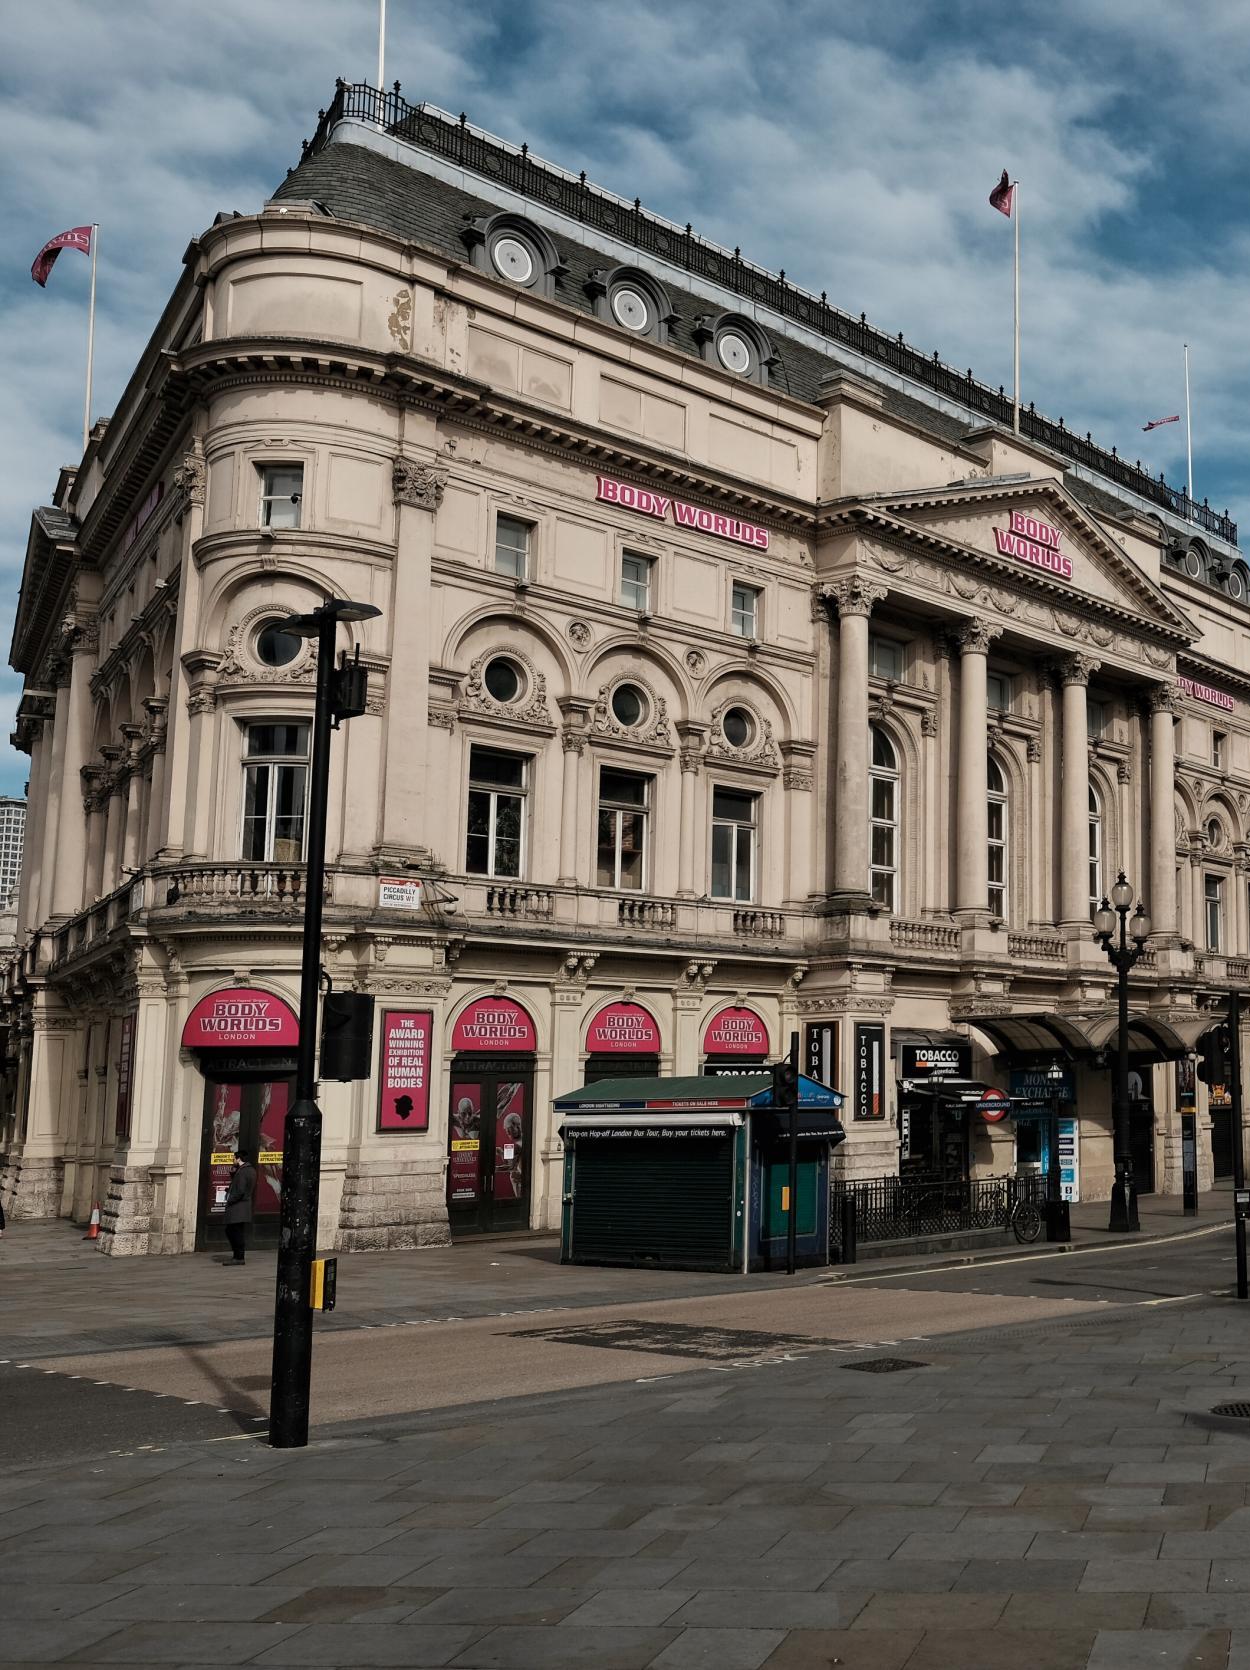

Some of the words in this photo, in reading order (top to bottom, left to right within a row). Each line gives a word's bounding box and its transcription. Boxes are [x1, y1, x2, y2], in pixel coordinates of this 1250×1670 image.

[596, 476, 672, 520] BODY
[671, 501, 769, 552] WORLDS
[1009, 509, 1063, 549] BODY
[993, 527, 1073, 580] WORLDS
[1177, 676, 1194, 695] DY
[1192, 685, 1235, 713] WORLDS
[384, 886, 416, 895] PICCADILLY
[213, 1002, 270, 1017] BODY
[200, 1017, 281, 1032] WORLDS
[400, 1020, 415, 1028] THE
[475, 1012, 518, 1025] BODY
[606, 1015, 645, 1028] BODY
[721, 1019, 755, 1031] BODY
[389, 1029, 424, 1039] AWARD
[462, 1024, 527, 1038] WORLDS
[595, 1027, 653, 1040] WORLDS
[712, 1030, 762, 1043] WORLDS
[389, 1039, 424, 1048] WINNING
[811, 1028, 820, 1079] TOBA
[915, 1050, 959, 1062] TOBACCO
[388, 1057, 399, 1066] OF
[401, 1057, 423, 1067] REAL
[387, 1067, 423, 1077] HUMAN
[387, 1078, 423, 1088] BODIES
[568, 1129, 588, 1138] Hop-on
[589, 1129, 610, 1138] Hop-off
[611, 1129, 632, 1137] London
[633, 1129, 644, 1137] Bus
[646, 1129, 660, 1137] Tour,
[661, 1129, 672, 1138] Buy
[675, 1130, 689, 1138] your
[690, 1128, 710, 1137] tickets
[711, 1128, 727, 1136] here.
[709, 1353, 808, 1372] LOOK
